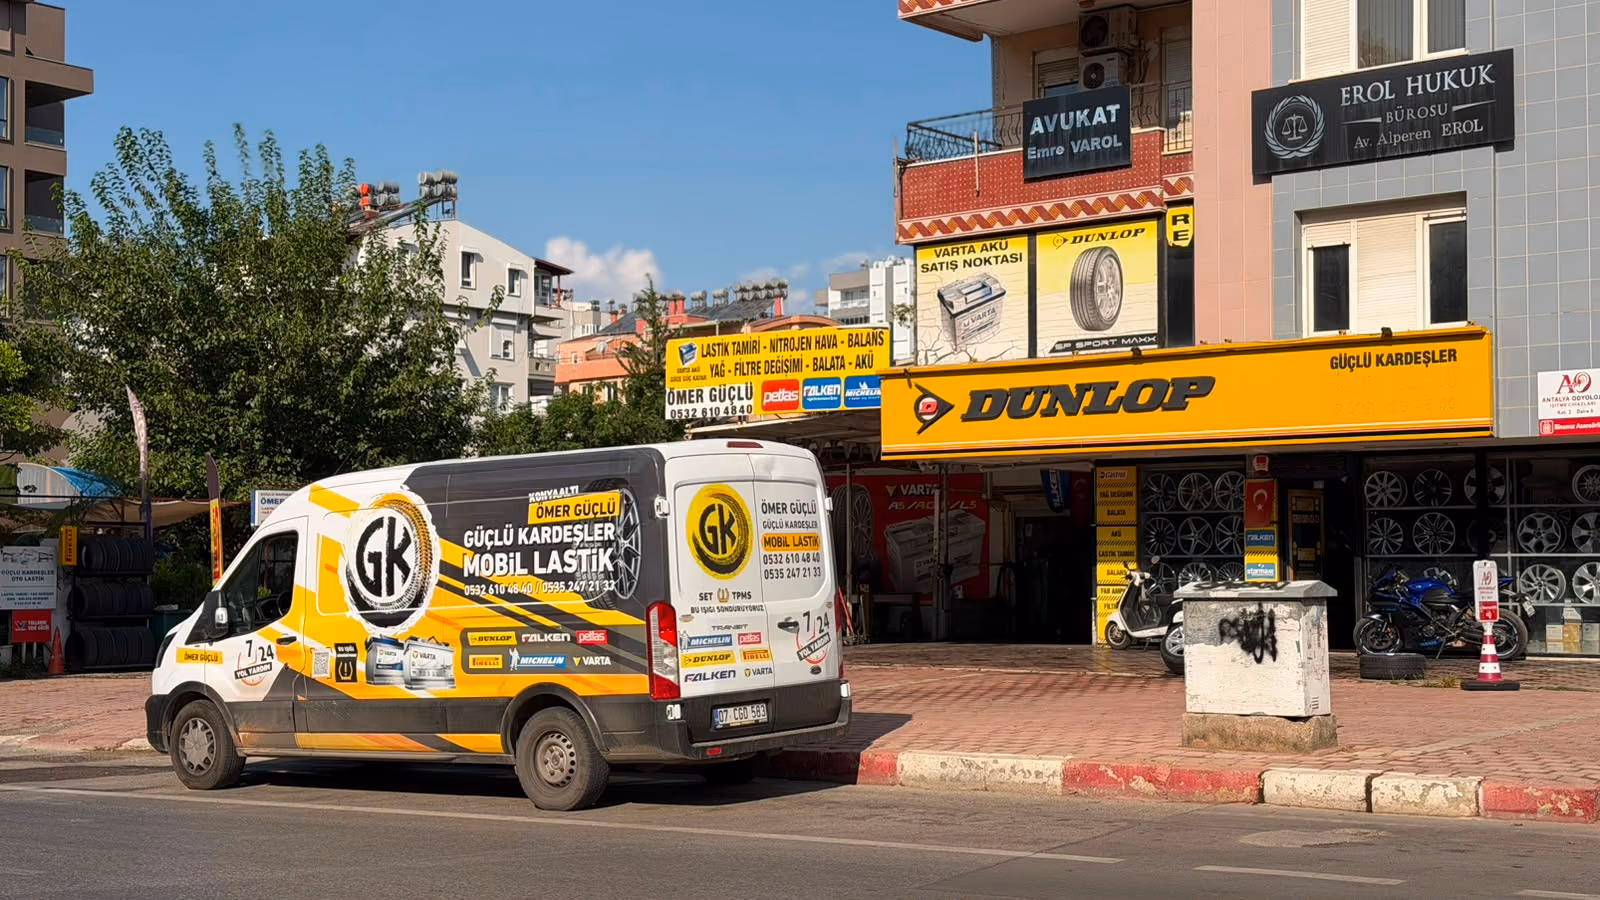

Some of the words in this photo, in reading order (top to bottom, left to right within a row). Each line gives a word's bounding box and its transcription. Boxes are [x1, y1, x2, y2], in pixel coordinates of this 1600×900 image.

[1340, 80, 1396, 107] EROL
[1406, 64, 1496, 97] HUKUK
[1030, 104, 1120, 135] AVUKAT
[1386, 103, 1449, 123] BÜROSU
[1354, 135, 1372, 149] Av.
[1377, 129, 1432, 147] Alperen
[1441, 119, 1484, 137] EROL
[1027, 145, 1065, 159] Emre
[1070, 134, 1122, 153] VAROL
[1070, 227, 1146, 245] DUNLOP
[934, 244, 977, 259] VARTA
[979, 239, 1009, 255] AKÜ
[920, 258, 959, 274] SATIŞ
[963, 252, 1023, 269] NOKTASI
[970, 306, 997, 325] VARTA
[701, 338, 730, 358] LASTİK
[731, 335, 761, 356] TAMİRİ
[769, 333, 812, 354] NİTROJEN
[814, 335, 838, 351] HAVA
[847, 330, 885, 349] BALANS
[1054, 342, 1073, 351] SP
[1075, 338, 1118, 349] SPORT
[1121, 335, 1156, 345] MAXX
[709, 359, 725, 378] YAĞ
[734, 357, 762, 376] FİLTRE
[764, 355, 803, 377] DEĞİŞİMİ
[812, 356, 846, 372] BALATA
[855, 350, 874, 369] AKÜ
[1330, 351, 1372, 373] GÜÇLÜ
[1375, 348, 1458, 368] KARDEŞLER
[667, 387, 704, 405] ÖMER
[709, 382, 754, 406] GÜÇLÜ
[803, 384, 841, 397] FALKEN
[960, 376, 1216, 422] DUNLOP
[670, 408, 697, 419] 0532
[701, 406, 720, 417] 610
[528, 485, 579, 503] KONYAALTI
[536, 501, 570, 519] ÖMER
[574, 497, 616, 518] GÜÇLÜ
[761, 498, 788, 515] ÖMER
[790, 499, 817, 517] GÜÇLÜ
[699, 503, 737, 556] GK
[762, 519, 784, 531] GÜÇLÜ
[785, 520, 818, 531] KARDEŞLER
[463, 524, 514, 551] GÜÇLÜ
[517, 523, 615, 546] KARDEŞLER
[356, 516, 415, 598] GK
[763, 553, 783, 565] 0532
[785, 553, 800, 564] 610
[801, 552, 811, 563] 48
[764, 568, 784, 580] 0535
[786, 567, 800, 579] 247
[803, 567, 811, 577] 21
[813, 566, 821, 577] 33
[464, 584, 489, 596] 0532
[489, 583, 505, 595] 610
[507, 582, 519, 594] 48
[521, 581, 533, 593] 40
[542, 580, 566, 593] 0535
[569, 579, 585, 592] 247
[588, 579, 600, 591] 21
[603, 578, 615, 591] 33
[698, 592, 713, 601] SET
[732, 591, 752, 600] TPMS
[690, 606, 700, 614] BU
[802, 611, 810, 632] 7
[816, 612, 830, 634] 24
[521, 633, 570, 643] FALKEN
[690, 635, 731, 646] MICHELIN
[184, 651, 199, 661] ÖMER
[200, 652, 218, 662] GÜÇLÜ
[245, 640, 253, 657] 7
[258, 645, 274, 661] 24
[419, 652, 436, 660] VARTA
[692, 653, 731, 664] DUNLOP
[520, 656, 565, 665] MICHELIN
[583, 656, 612, 666] VARTA
[236, 670, 249, 678] YOL
[248, 663, 271, 676] YARDIM
[684, 669, 736, 683] FALKEN
[752, 667, 773, 676] VARTA
[719, 709, 728, 722] 07
[750, 705, 765, 718] 583
